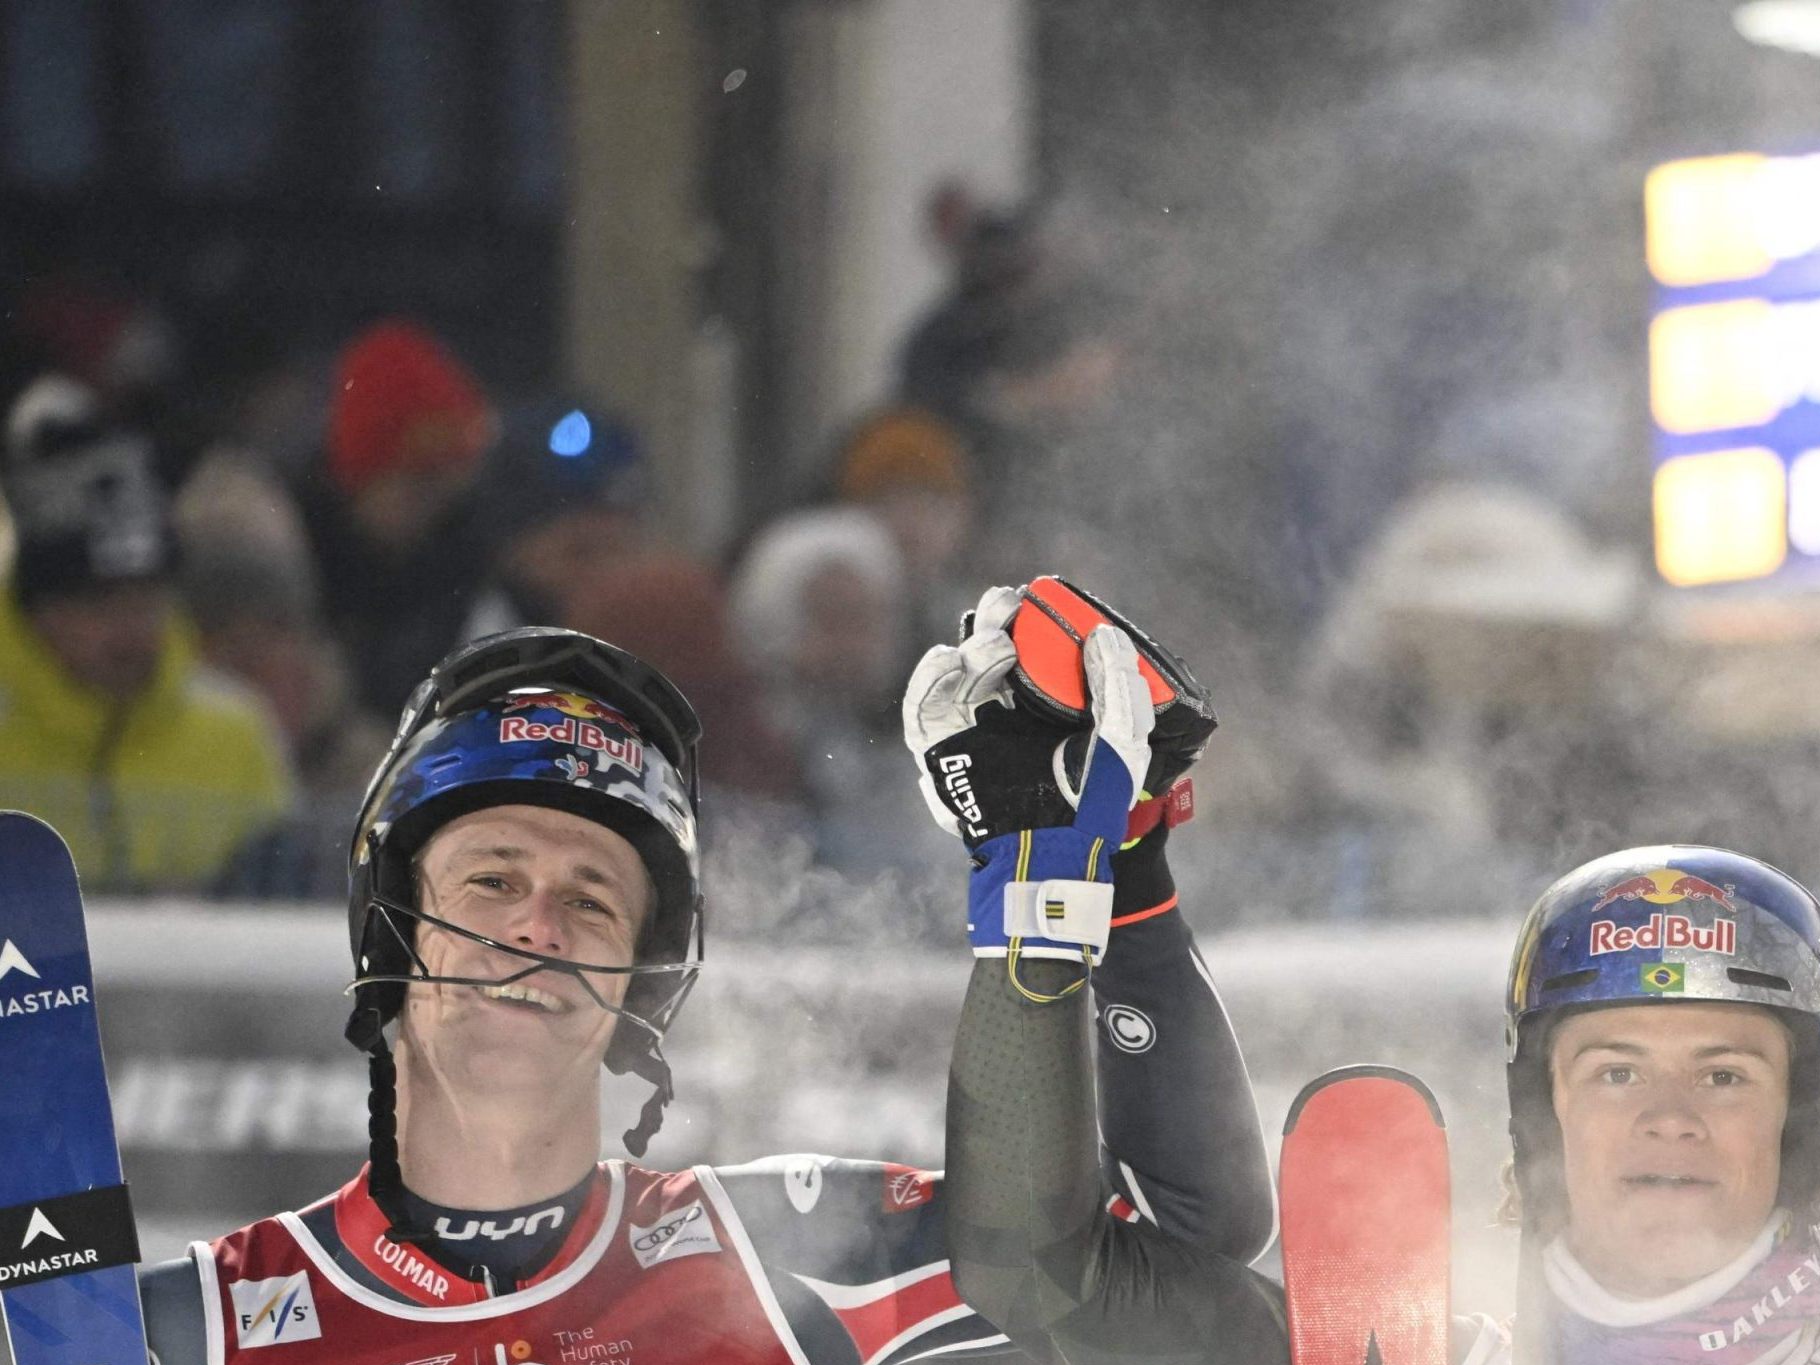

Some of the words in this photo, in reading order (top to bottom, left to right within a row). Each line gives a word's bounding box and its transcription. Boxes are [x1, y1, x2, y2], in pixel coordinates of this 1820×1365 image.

[500, 717, 576, 744] Red
[578, 722, 643, 772] Bull
[939, 754, 988, 838] racing
[1590, 914, 1662, 956] Red
[1664, 916, 1736, 956] Bull
[0, 1249, 98, 1282] DYNASTAR
[374, 1233, 449, 1300] COLMAR
[553, 1327, 594, 1347] The
[560, 1339, 633, 1362] Human
